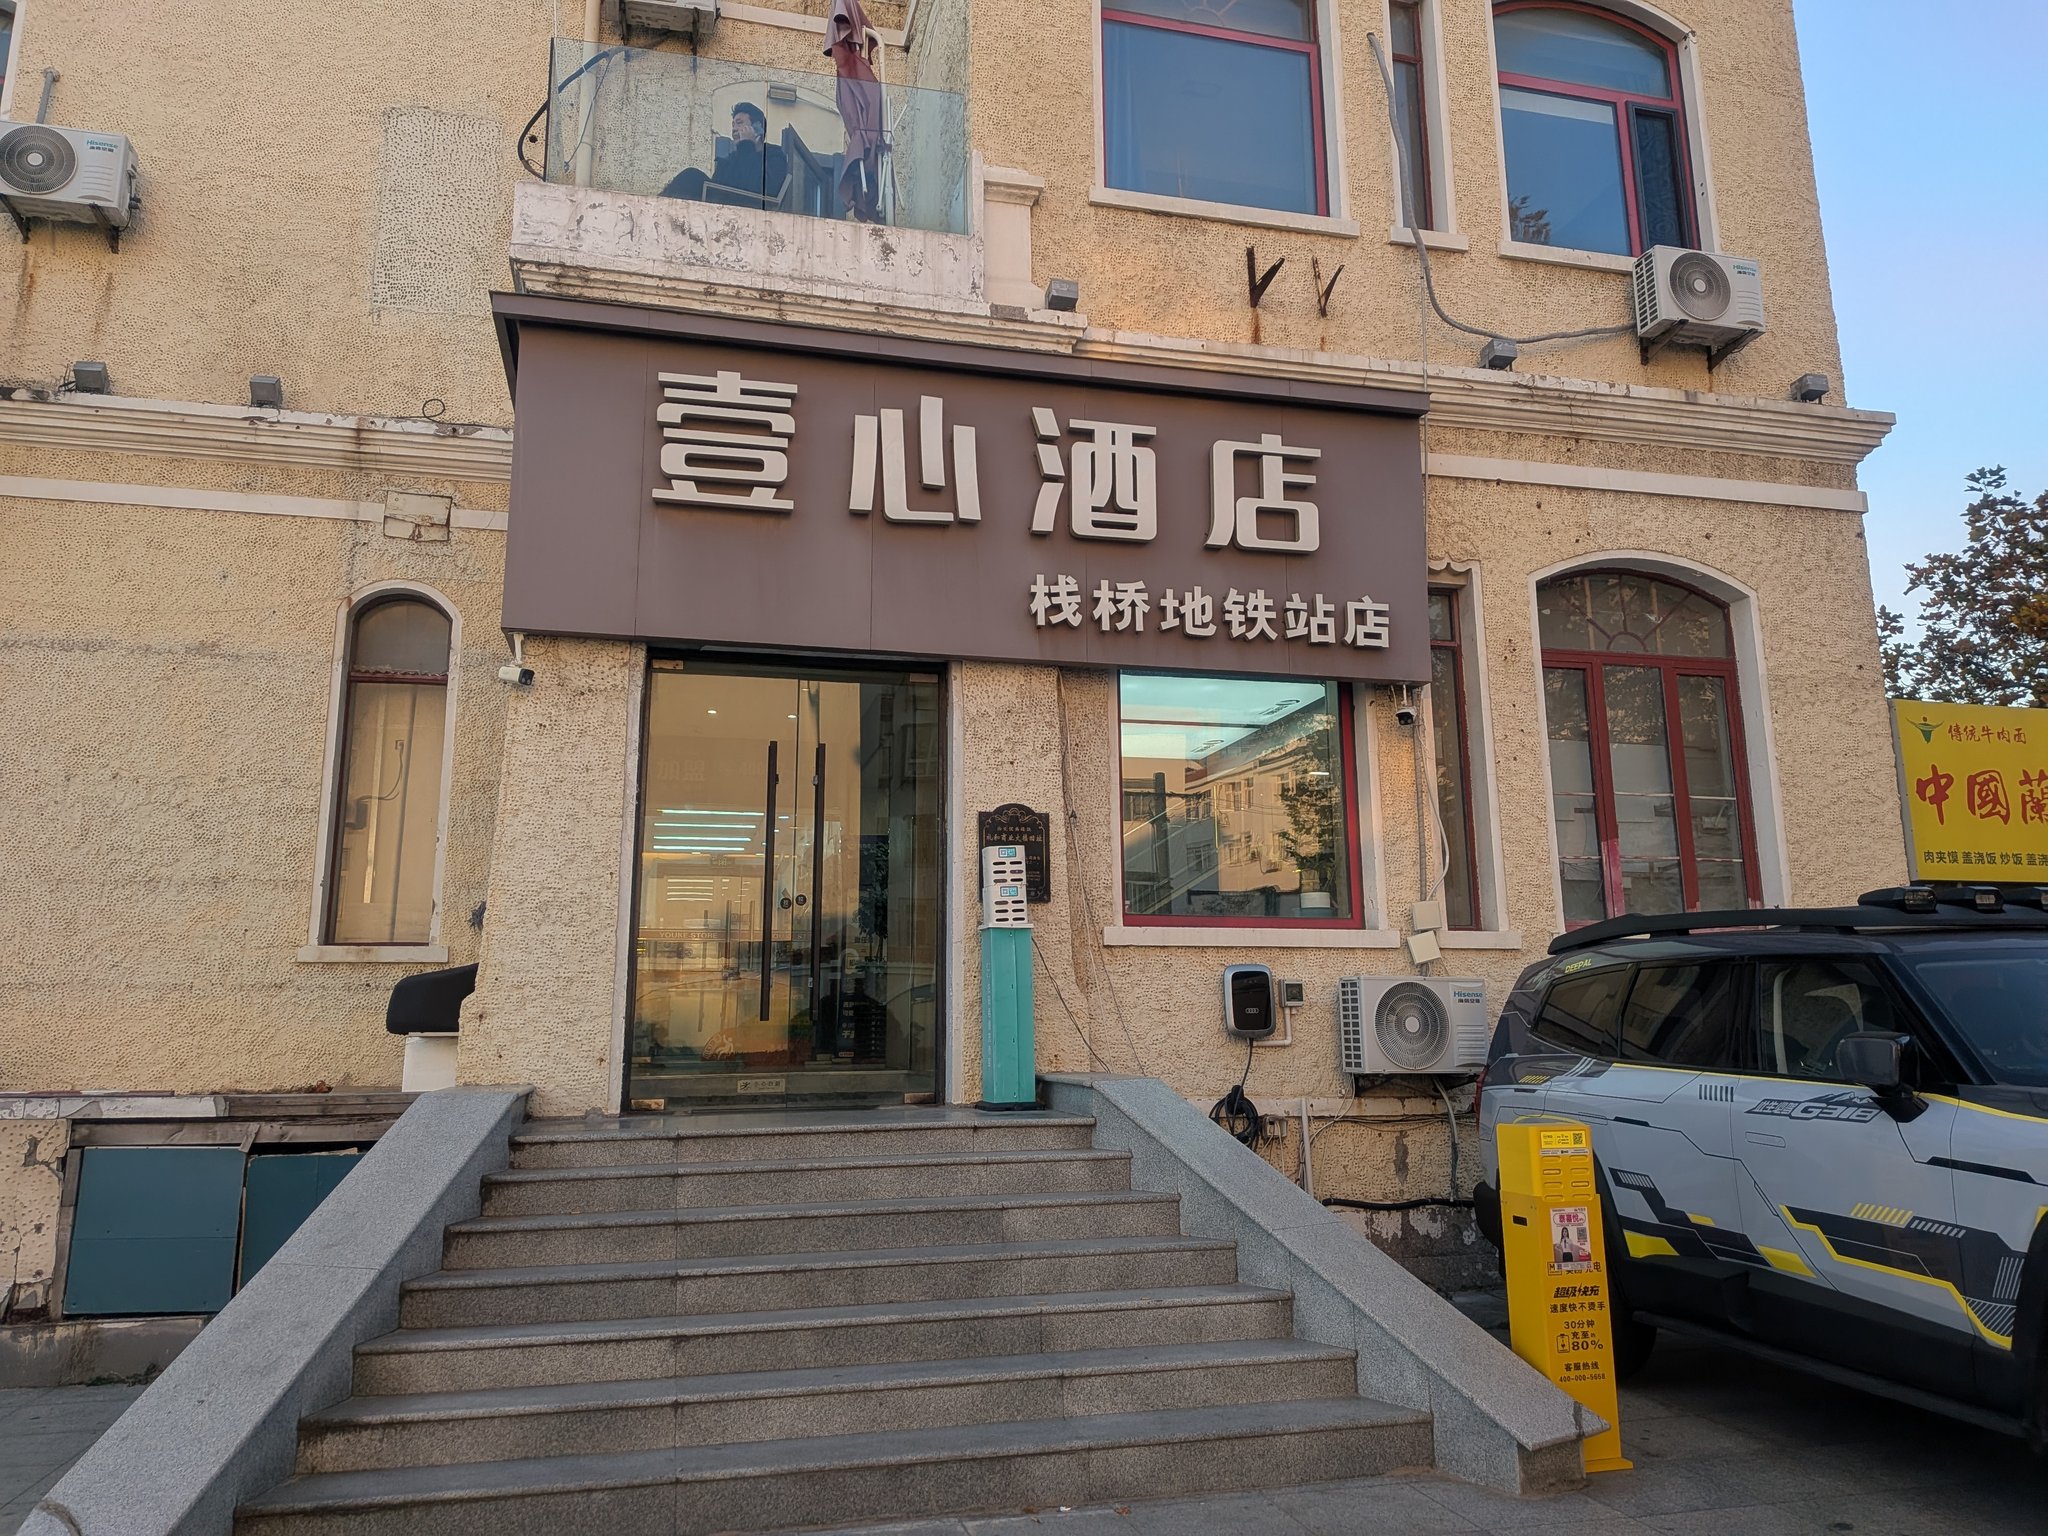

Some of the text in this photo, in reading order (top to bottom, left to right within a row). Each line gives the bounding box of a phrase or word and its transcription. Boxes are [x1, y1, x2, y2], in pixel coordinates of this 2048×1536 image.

[87, 140, 119, 148] Hisense
[651, 370, 1322, 554] 壹心酒店
[1029, 573, 1391, 650] 栈桥地铁站店
[1962, 851, 1997, 865] 盖浇饭
[2000, 852, 2023, 866] 炒饭
[1564, 958, 1592, 973] DEEPAL
[1553, 1283, 1600, 1299] 超级快充
[1549, 1301, 1606, 1314] 速度快不烫手
[1563, 1319, 1595, 1329] 30分钟
[1571, 1339, 1604, 1351] 80%
[1564, 1361, 1600, 1372] 客服热线
